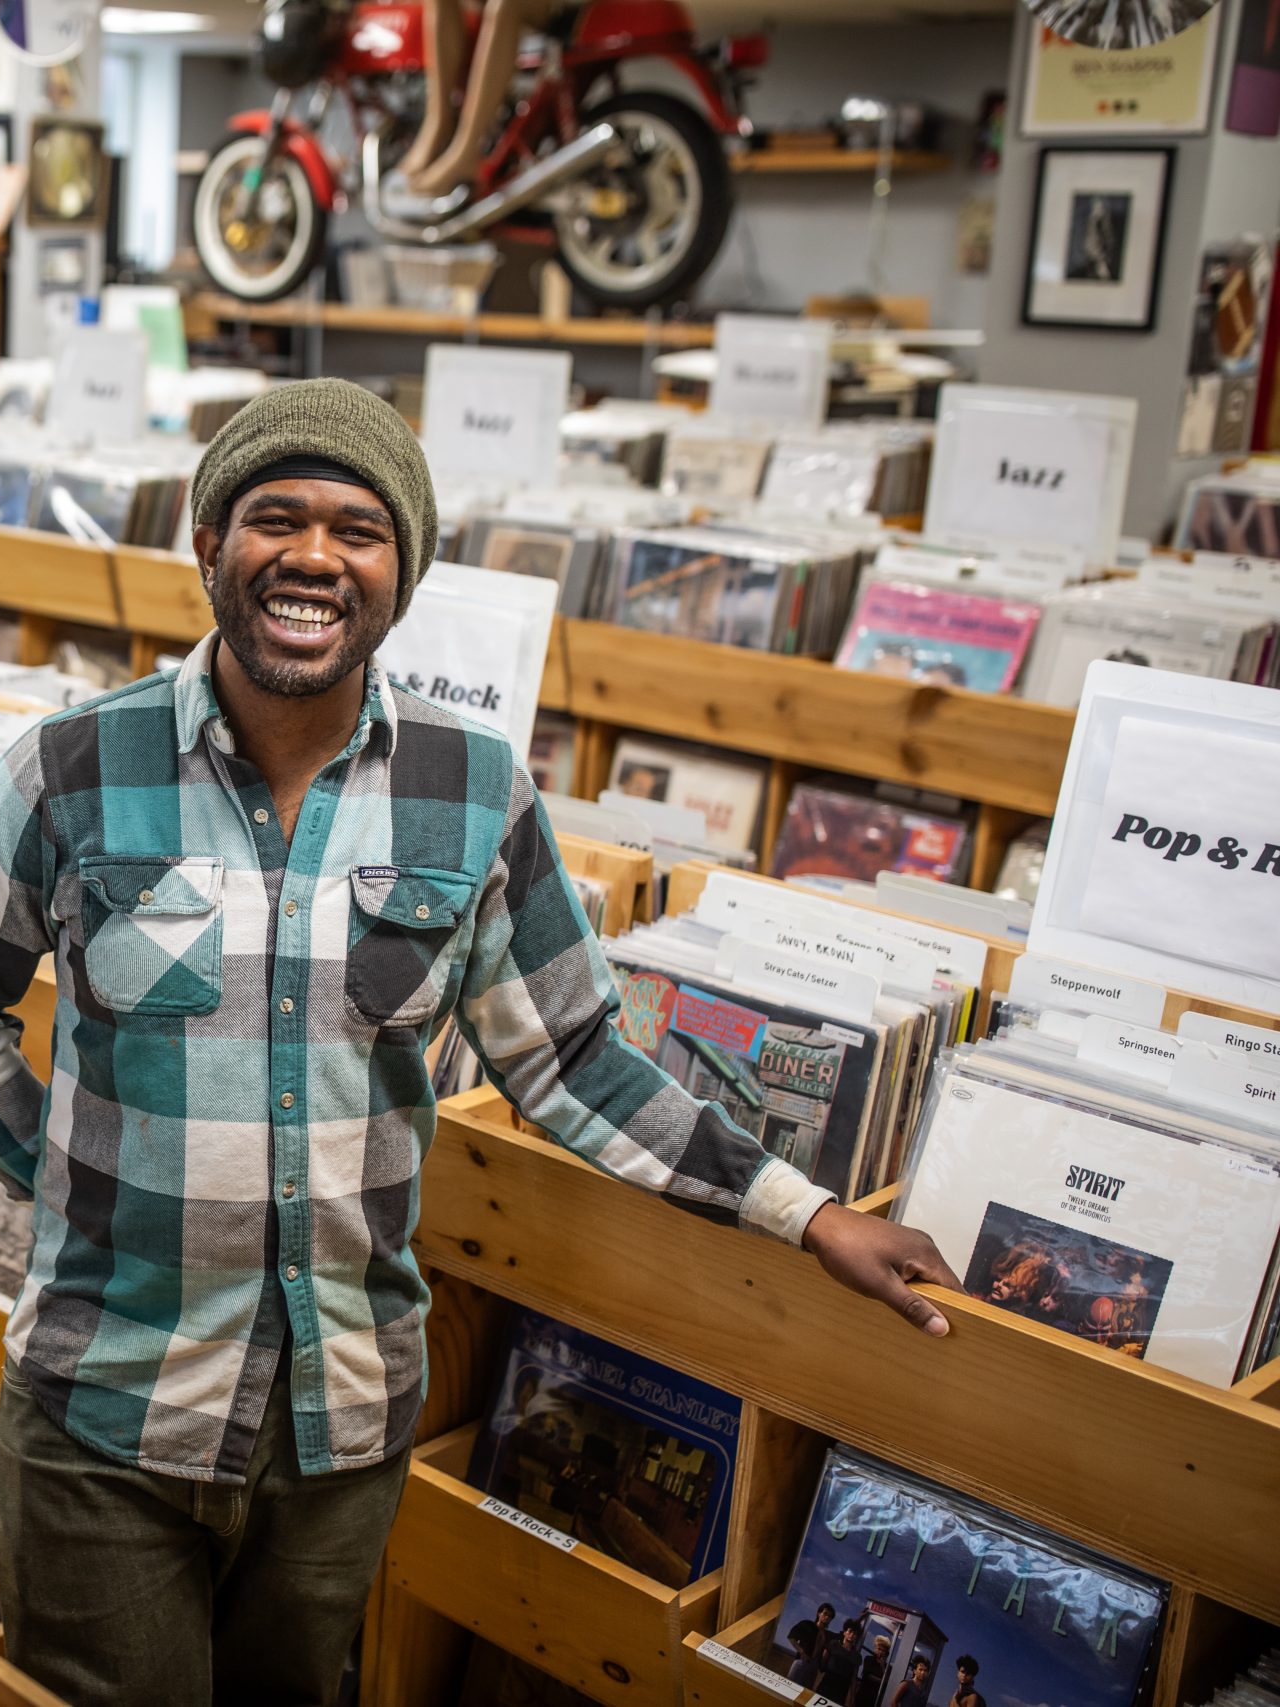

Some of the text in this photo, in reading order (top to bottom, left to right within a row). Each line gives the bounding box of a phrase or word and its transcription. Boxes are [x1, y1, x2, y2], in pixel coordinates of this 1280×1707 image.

[996, 457, 1065, 490] Jazz
[428, 676, 501, 711] Rock
[1112, 813, 1202, 862] Pop
[1207, 836, 1248, 870] &
[362, 868, 398, 879] Dickies
[764, 961, 787, 977] Stray
[786, 968, 805, 980] Cats
[811, 974, 839, 989] Setzer
[1050, 973, 1121, 1000] Steppenwolf
[1118, 1036, 1176, 1060] Springsteen
[1225, 1033, 1261, 1052] Ringo
[760, 1051, 834, 1085] DINER
[1244, 1083, 1276, 1101] Spirit
[1065, 1164, 1126, 1202] SPIRIT
[1060, 1201, 1069, 1210] OF
[1077, 1207, 1112, 1224] SARDONICUS
[1067, 1194, 1110, 1214] TWELVE DREAMS
[629, 1374, 741, 1437] STANLEY
[484, 1498, 509, 1516] Pop
[510, 1511, 519, 1521] &
[520, 1516, 554, 1539] Rock
[562, 1538, 575, 1549] S
